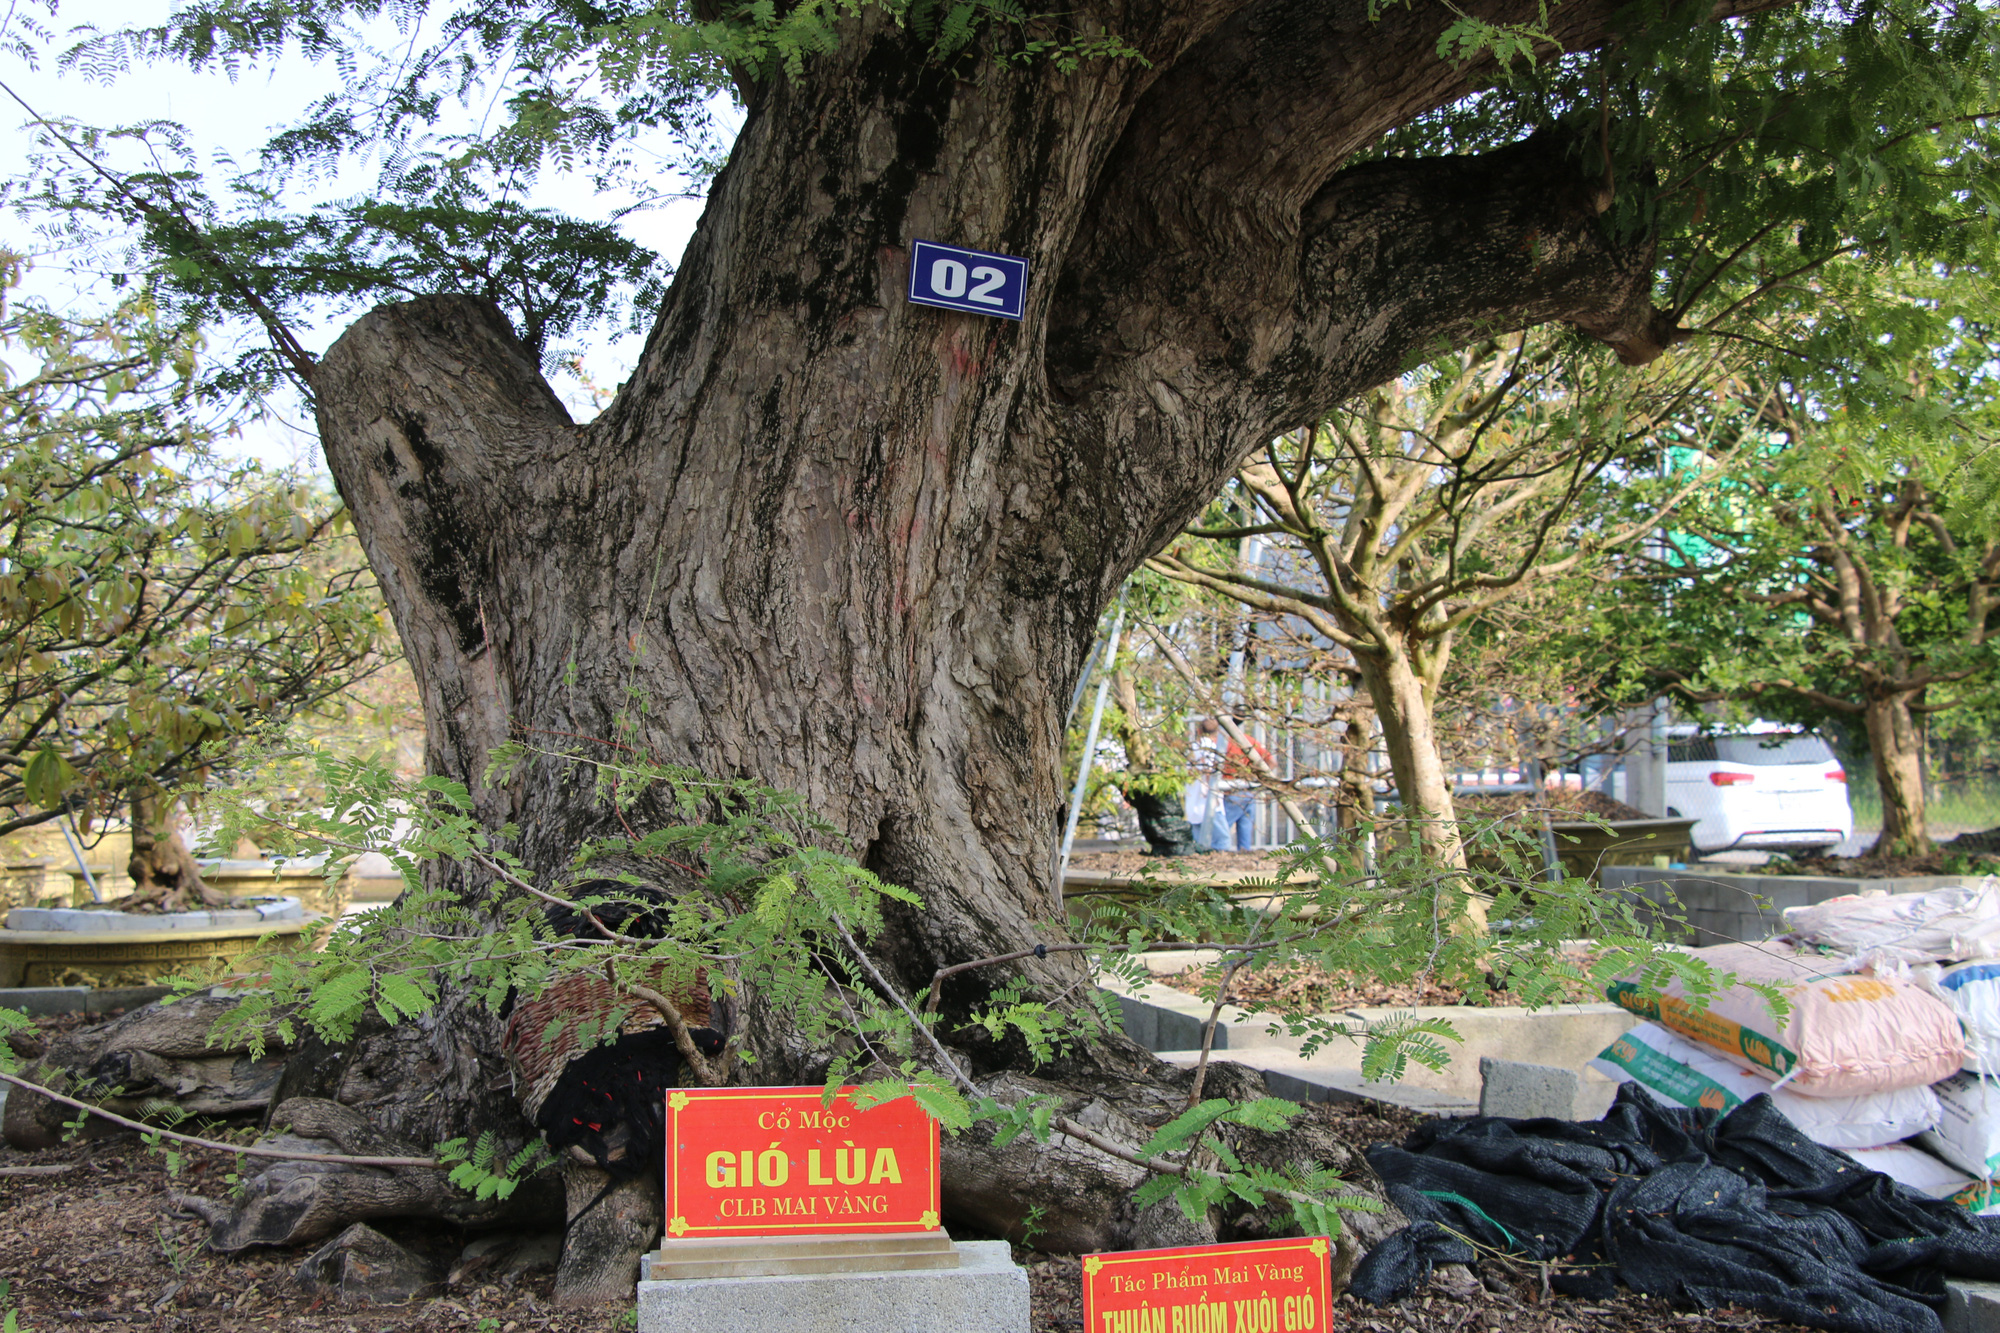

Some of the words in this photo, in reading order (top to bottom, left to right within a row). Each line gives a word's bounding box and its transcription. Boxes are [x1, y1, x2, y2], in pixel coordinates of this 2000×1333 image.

[930, 258, 1007, 307] 02
[757, 1107, 792, 1130] Cổ
[799, 1110, 851, 1134] Mộc
[705, 1141, 789, 1189] GIÓ
[808, 1140, 903, 1186] LÙA
[719, 1198, 767, 1218] CLB
[773, 1196, 817, 1216] MAI
[823, 1190, 889, 1215] VÀNG
[1110, 1275, 1146, 1294] Tác
[1151, 1264, 1209, 1290] Phẩm
[1213, 1264, 1249, 1286] Mai
[1254, 1263, 1304, 1283] Vàng
[1172, 1290, 1229, 1333] BUỒM
[1234, 1290, 1279, 1333] XUÔI
[1284, 1286, 1316, 1332] GIÓ
